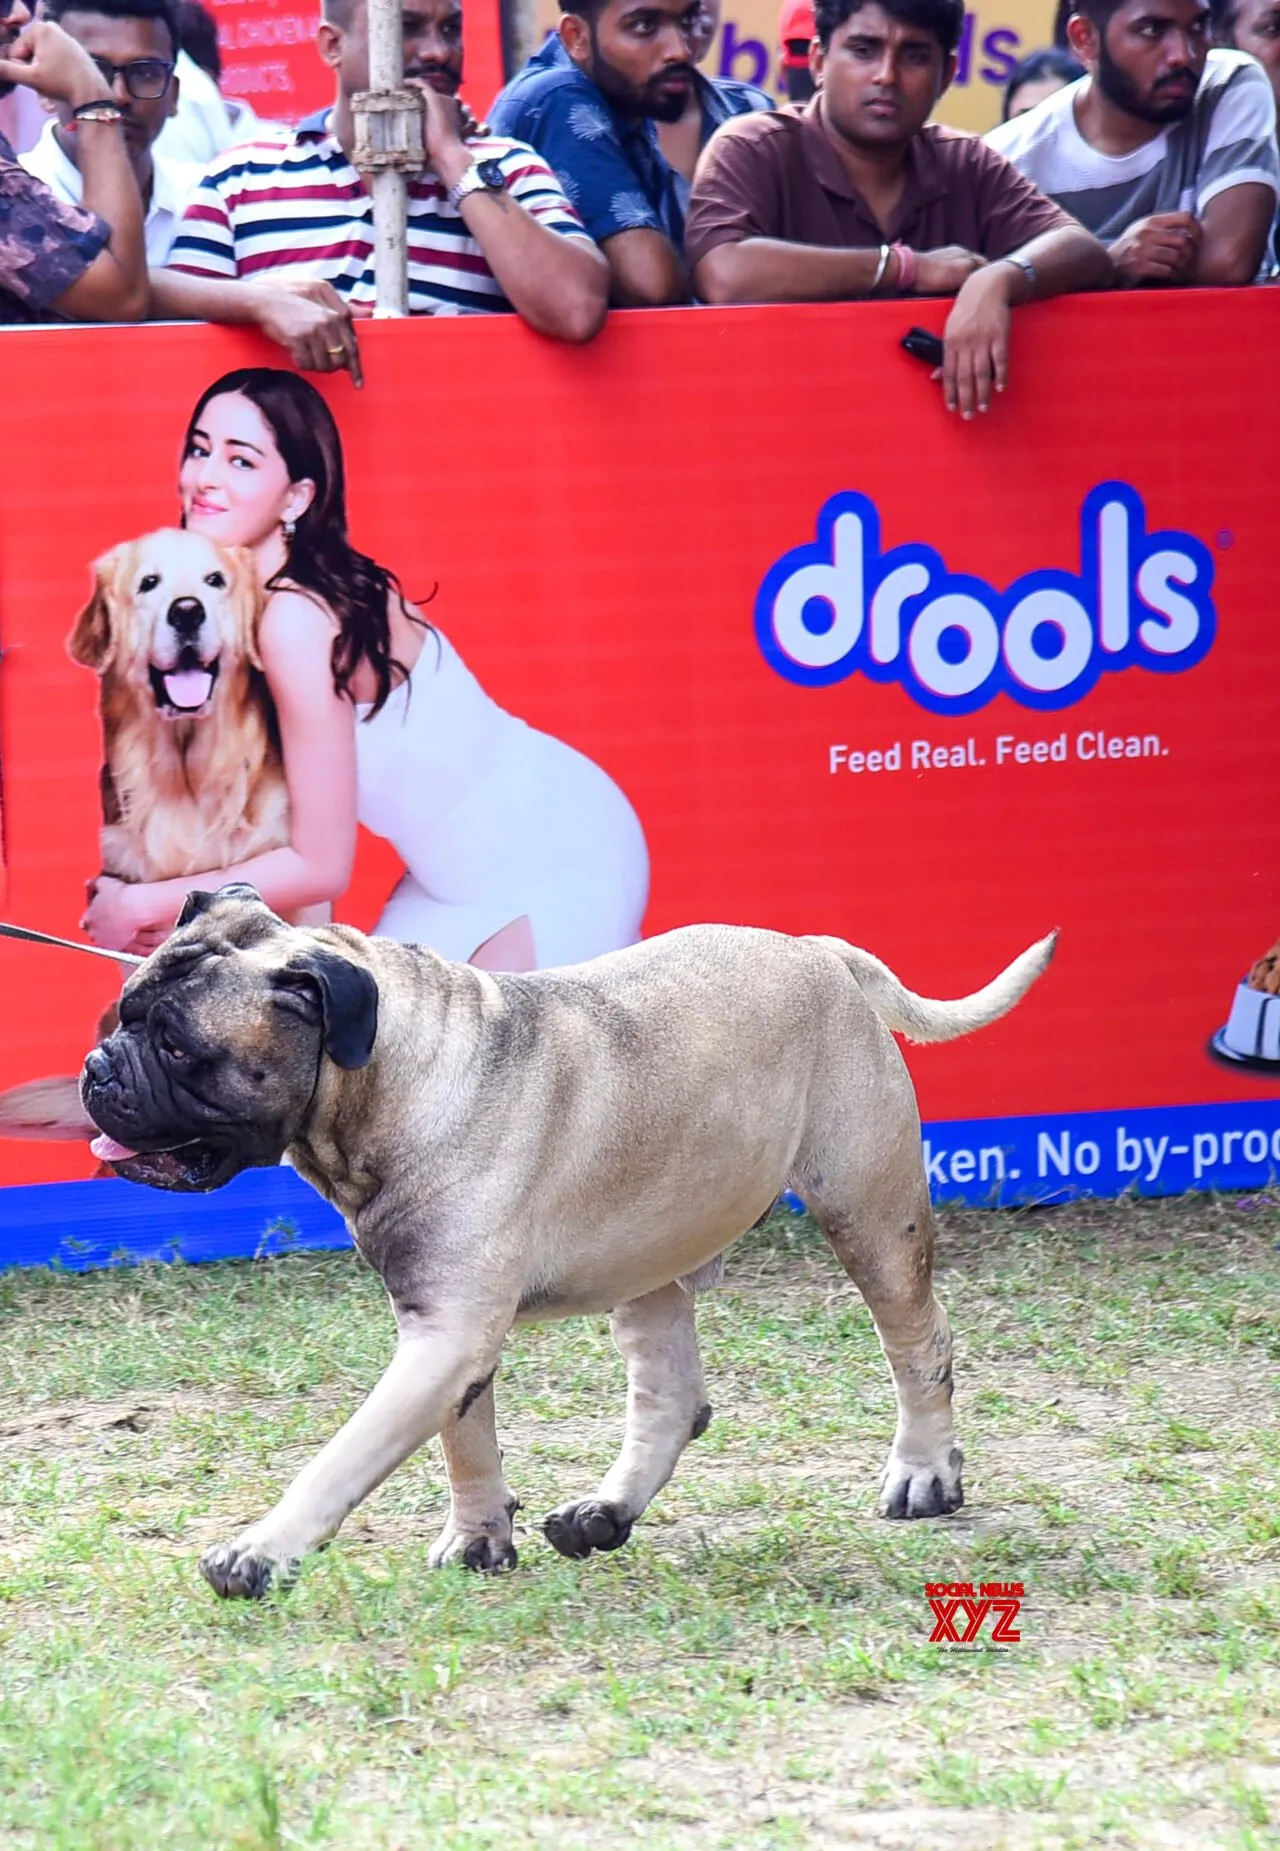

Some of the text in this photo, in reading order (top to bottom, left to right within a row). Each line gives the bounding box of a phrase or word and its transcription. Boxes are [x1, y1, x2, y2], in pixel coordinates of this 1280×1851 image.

[770, 497, 1202, 699] drools
[829, 730, 1169, 774] Feed Real. Feed Clean.
[922, 1139, 1021, 1184] ken.
[1037, 1130, 1101, 1178] No
